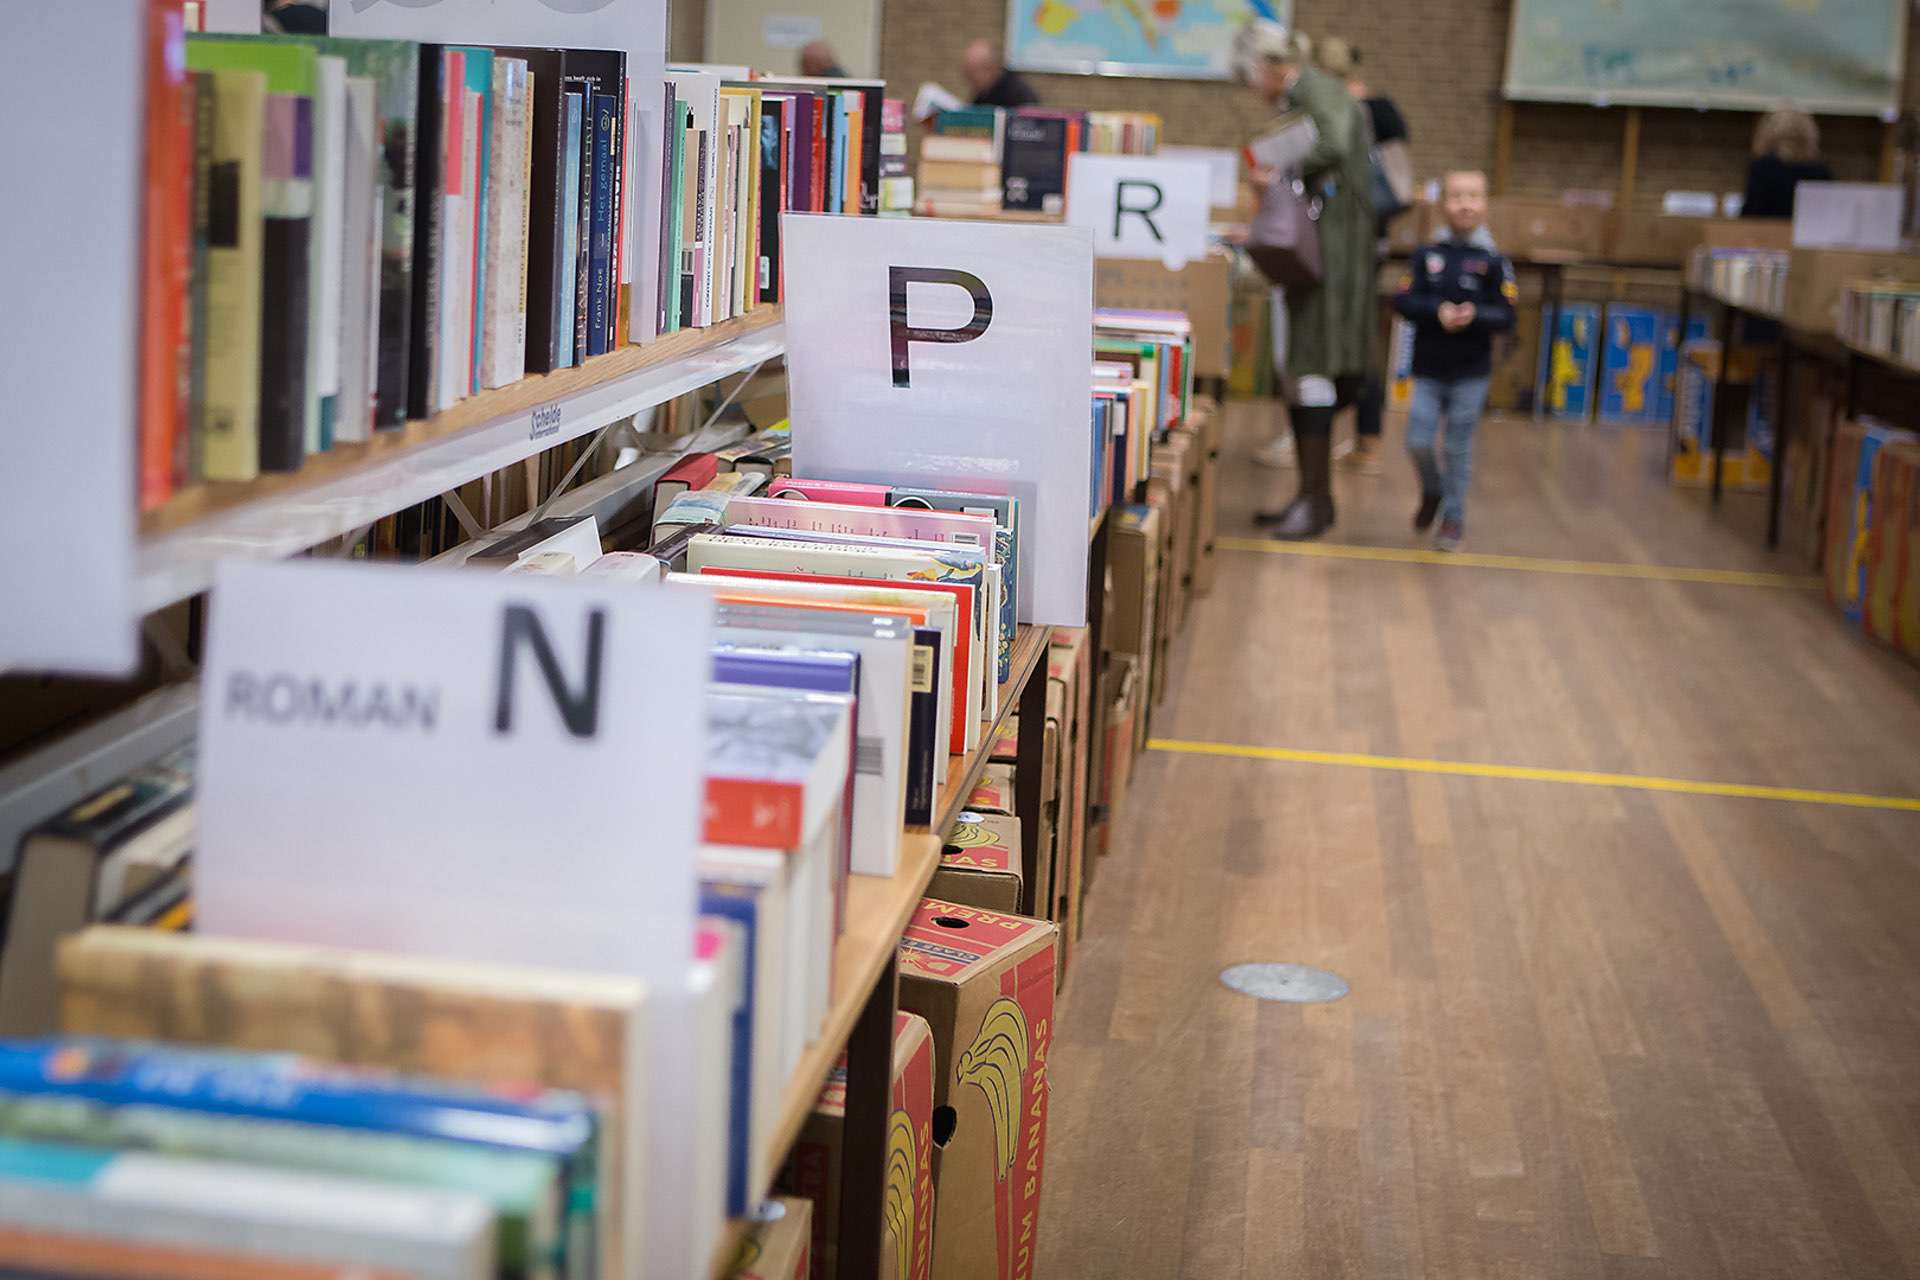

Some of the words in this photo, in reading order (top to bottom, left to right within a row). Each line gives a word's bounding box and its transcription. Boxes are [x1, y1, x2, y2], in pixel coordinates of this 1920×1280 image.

[598, 139, 608, 190] gemaal
[597, 191, 607, 223] Het
[1113, 178, 1164, 242] R
[594, 298, 603, 329] Frank
[888, 265, 993, 388] P
[224, 671, 443, 732] ROMAN
[492, 602, 608, 739] N
[1024, 1018, 1048, 1200] BANANAS
